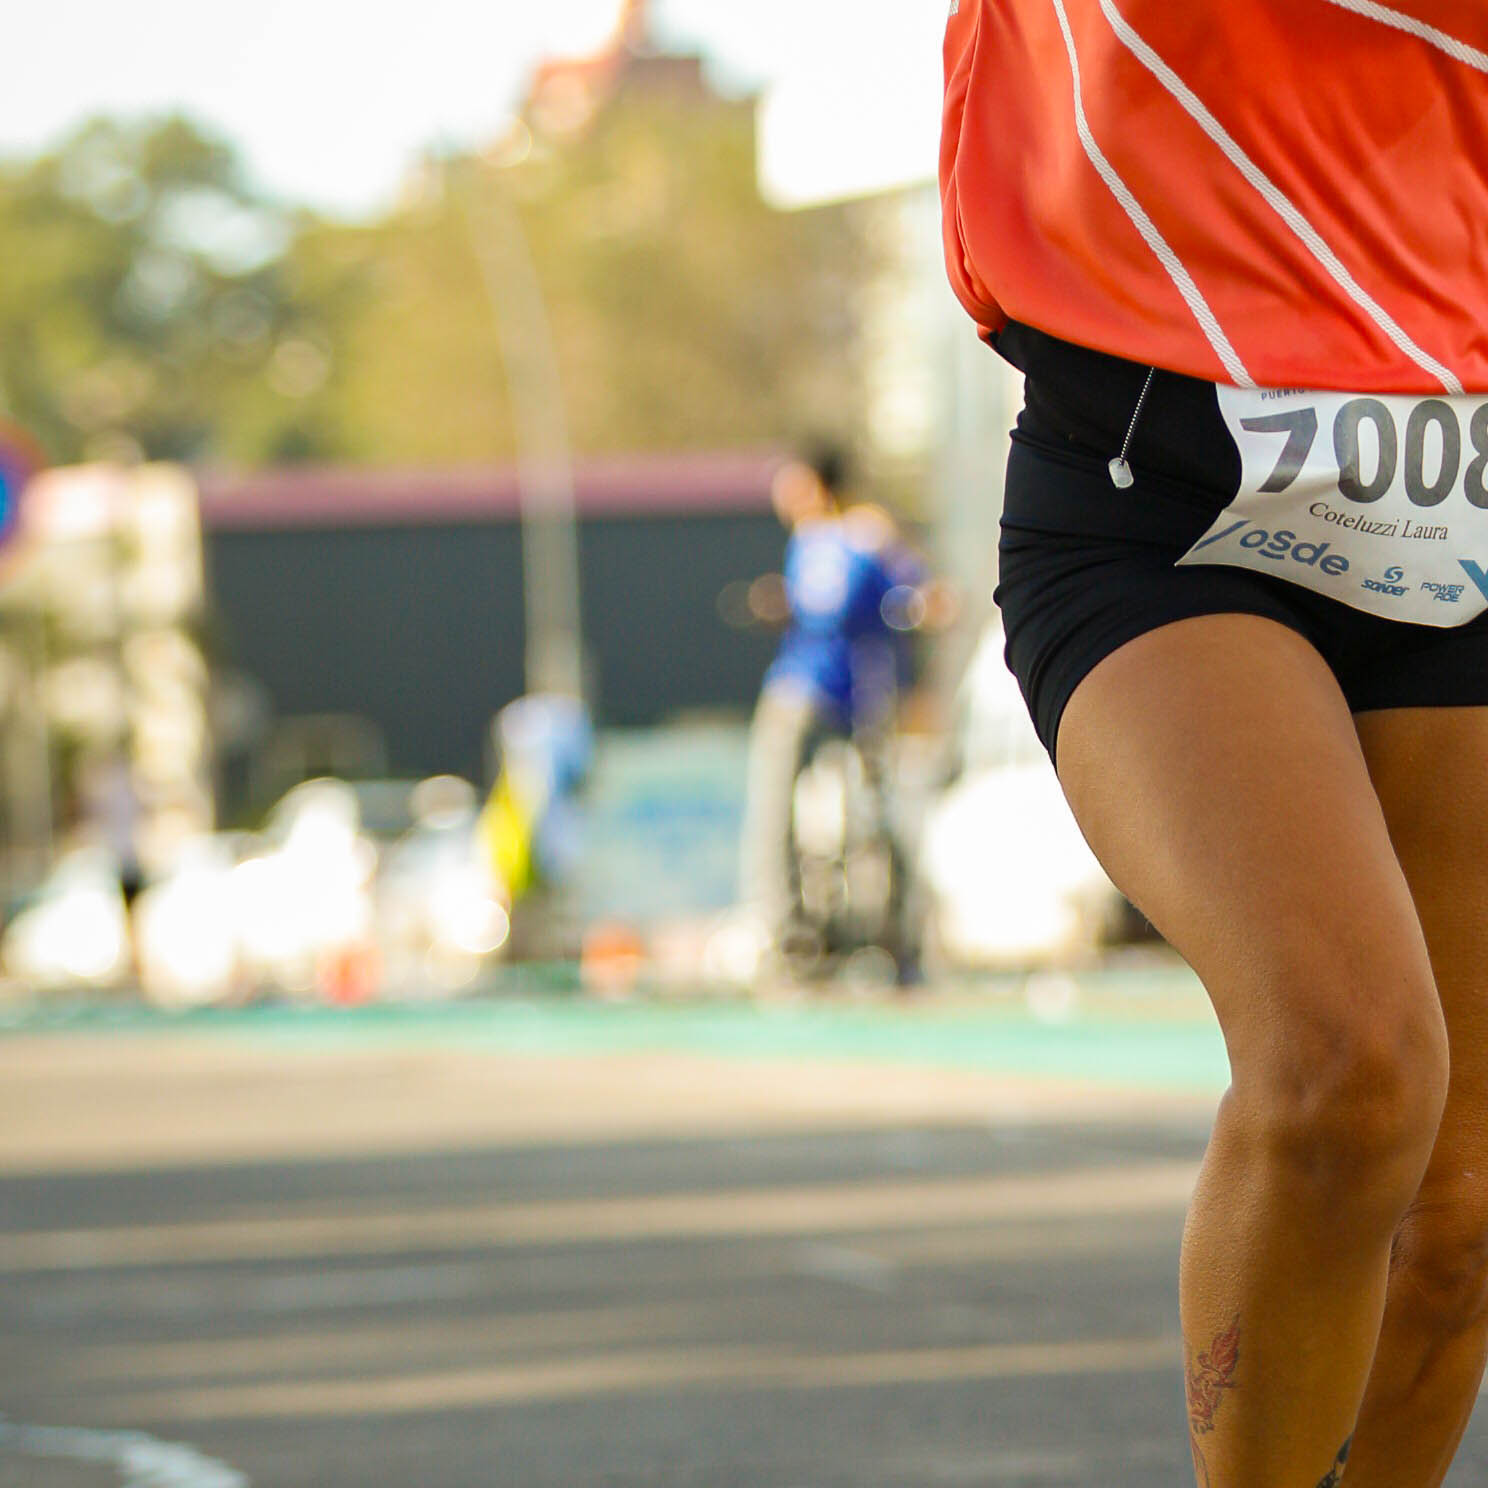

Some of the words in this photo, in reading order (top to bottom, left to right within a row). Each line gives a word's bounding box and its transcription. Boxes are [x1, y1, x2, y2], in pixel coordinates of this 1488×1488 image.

[1308, 501, 1400, 537] Coteluzzi
[1401, 519, 1449, 540] Laura
[1239, 529, 1350, 576] osde
[1420, 582, 1465, 594] POWER
